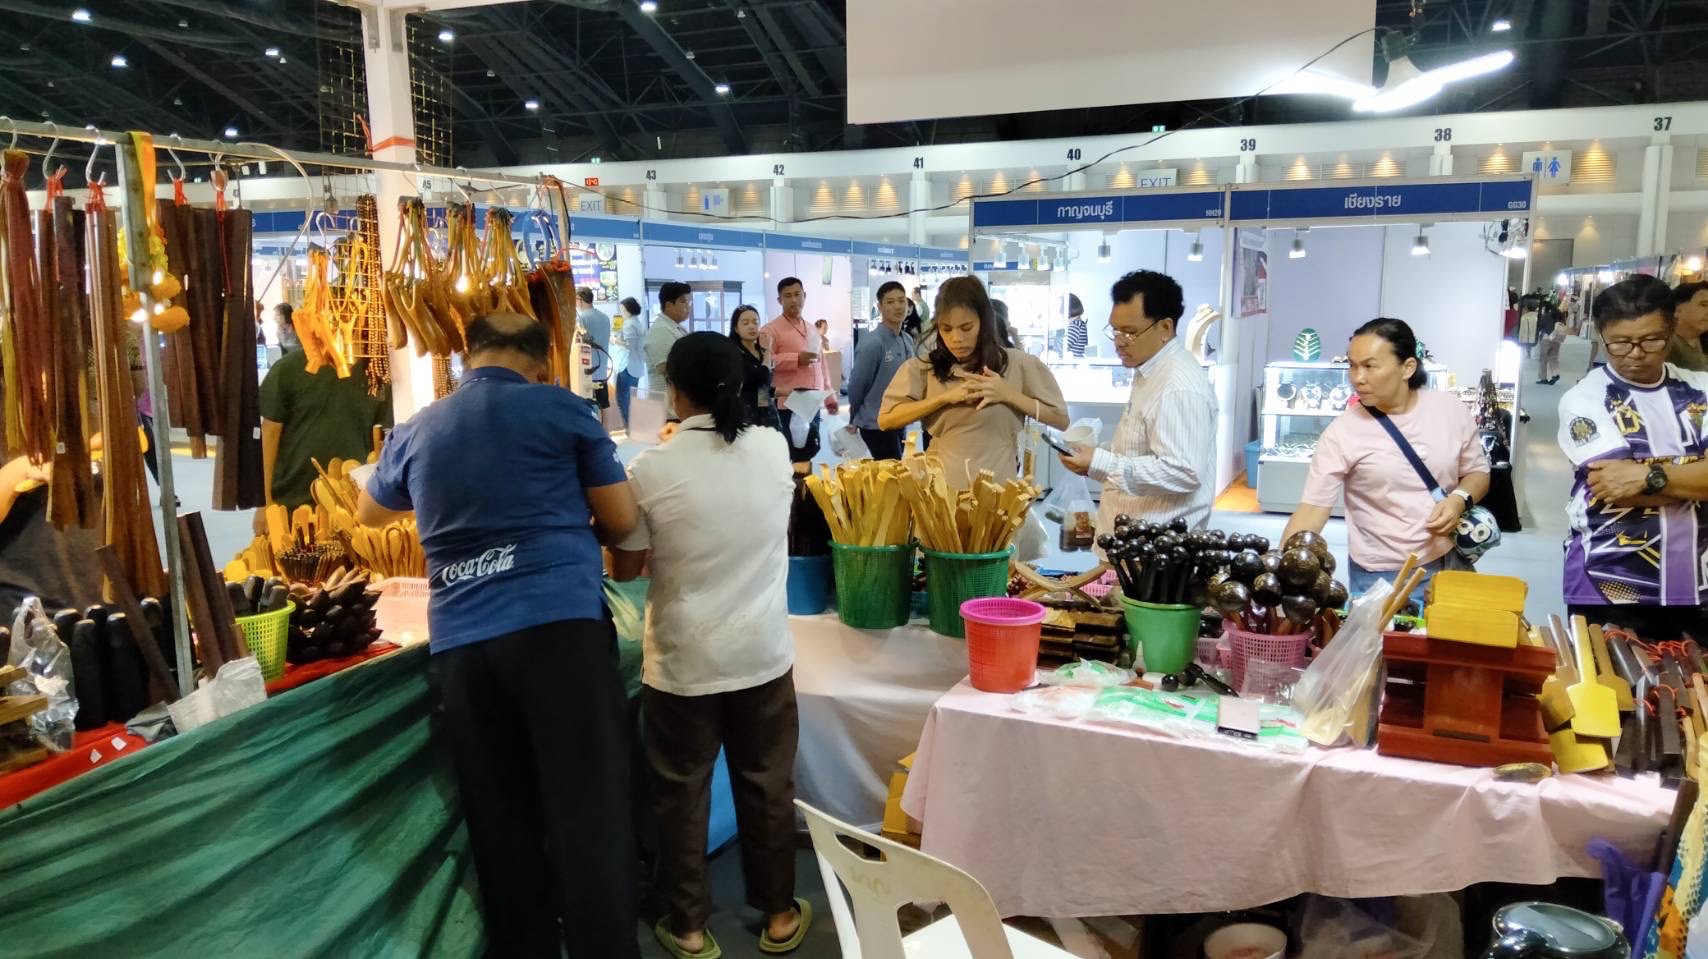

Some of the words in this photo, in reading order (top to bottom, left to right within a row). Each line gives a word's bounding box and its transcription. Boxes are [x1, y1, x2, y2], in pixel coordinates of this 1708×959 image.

[1654, 117, 1672, 131] 37
[1434, 128, 1452, 142] 38
[1240, 138, 1256, 152] 39
[1066, 148, 1081, 161] 40
[773, 164, 785, 176] 42
[913, 157, 924, 169] 41
[645, 170, 657, 181] 43
[580, 200, 601, 212] EXIT
[1344, 192, 1402, 209] เชียงราย
[1057, 200, 1113, 220] กาญจนบุรี
[442, 544, 517, 587] Coca-Cola
